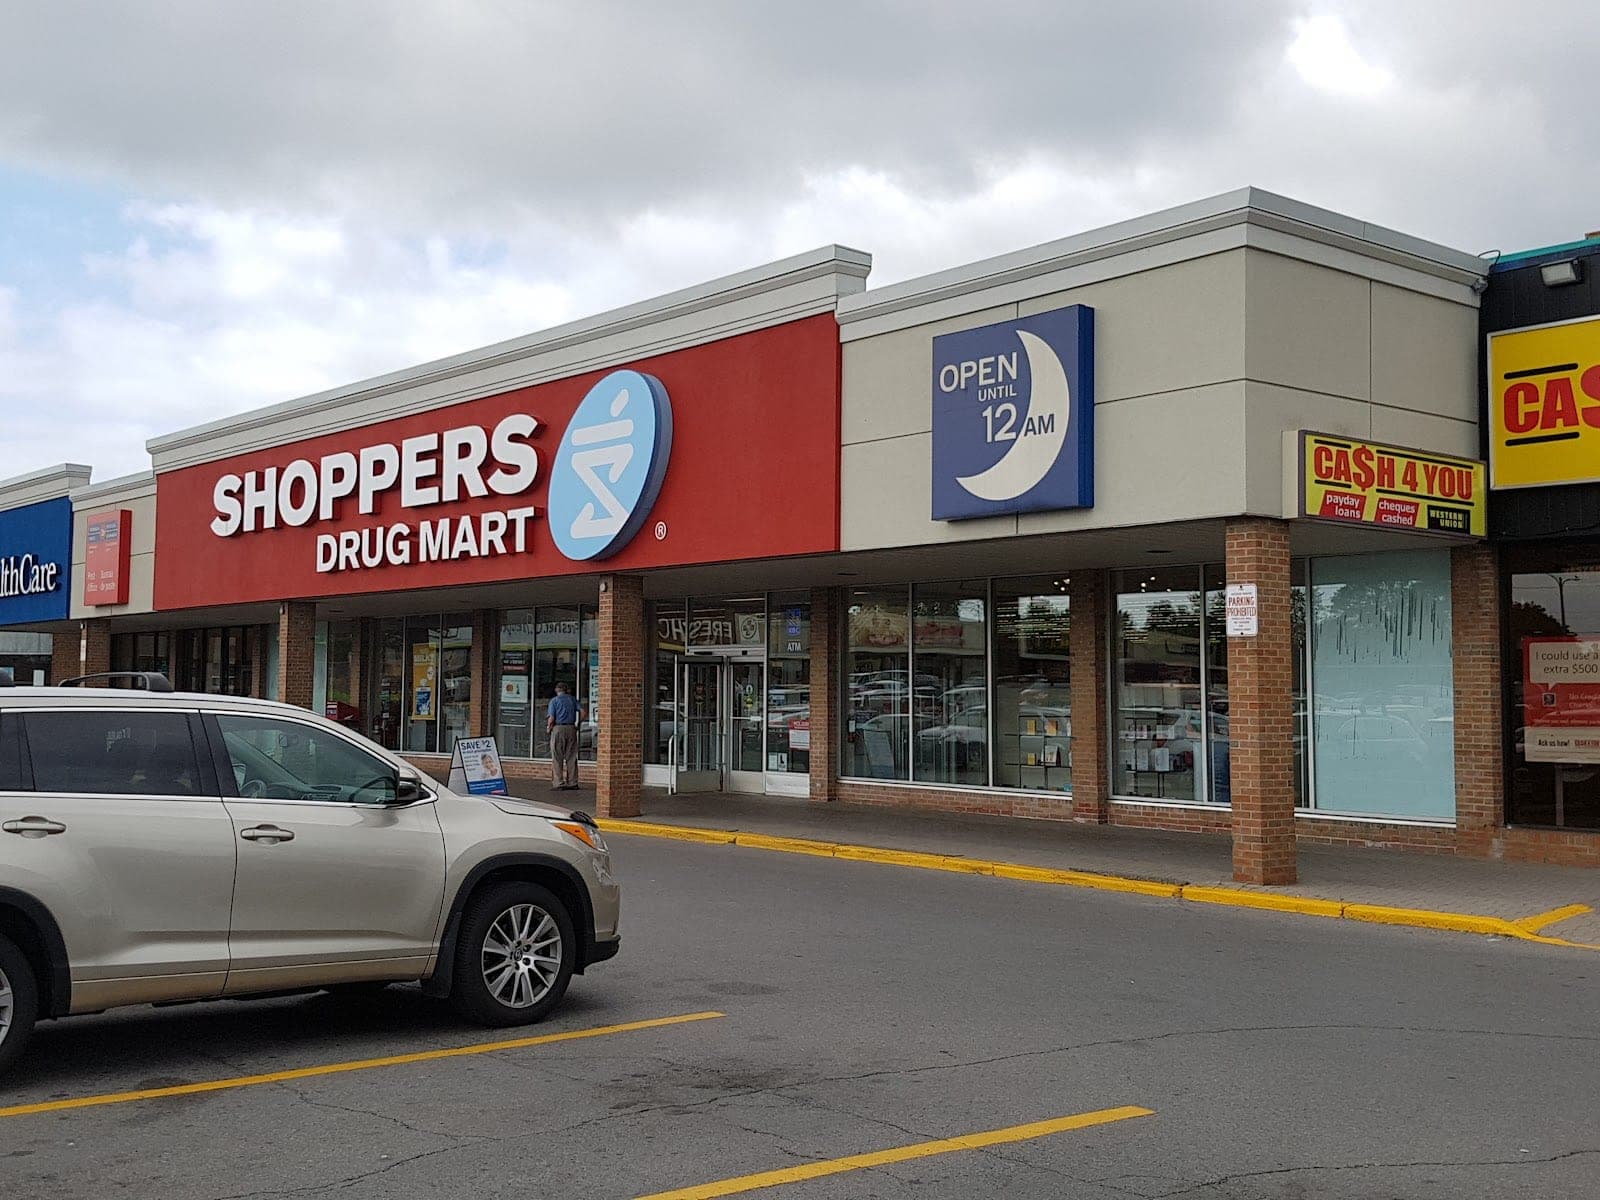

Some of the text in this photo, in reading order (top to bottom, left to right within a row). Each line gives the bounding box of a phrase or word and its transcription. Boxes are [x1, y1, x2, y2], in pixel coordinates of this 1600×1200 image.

[939, 352, 1018, 393] OPEN
[978, 384, 1018, 402] UNTIL
[982, 403, 1055, 443] 12 AM
[210, 413, 540, 538] SHOPPERS
[1313, 444, 1473, 500] CA$H 4 YOU
[1326, 493, 1361, 508] payday
[1378, 500, 1416, 514] cheques
[1334, 506, 1361, 519] loans
[1429, 510, 1464, 522] WESTERN
[1381, 514, 1414, 526] cashed
[1439, 518, 1464, 529] UNION
[316, 506, 535, 573] DRUG MART
[1228, 596, 1255, 607] PARKING
[787, 642, 802, 651] ATM
[1541, 650, 1569, 661] could
[1572, 651, 1590, 661] use
[1543, 663, 1598, 674] extra $500
[461, 741, 481, 751] SAVE
